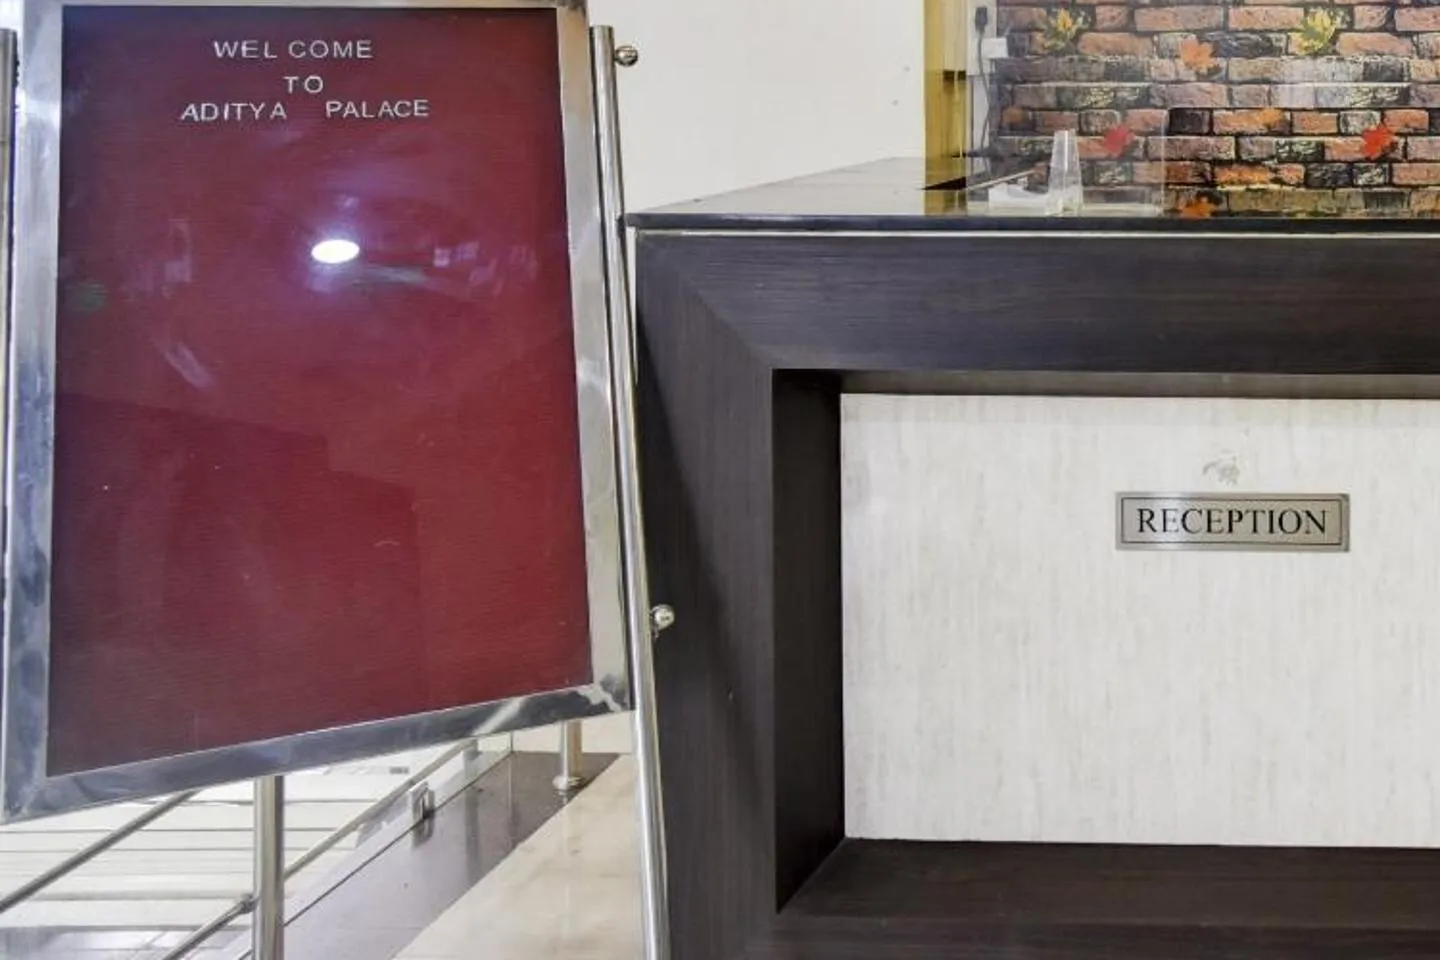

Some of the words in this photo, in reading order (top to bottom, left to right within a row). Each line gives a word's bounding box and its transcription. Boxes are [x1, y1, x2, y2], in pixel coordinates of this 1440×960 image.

[283, 75, 323, 94] TO
[180, 102, 288, 122] ADITYA
[325, 99, 430, 119] PALACE
[1137, 508, 1329, 535] RECEPTION
